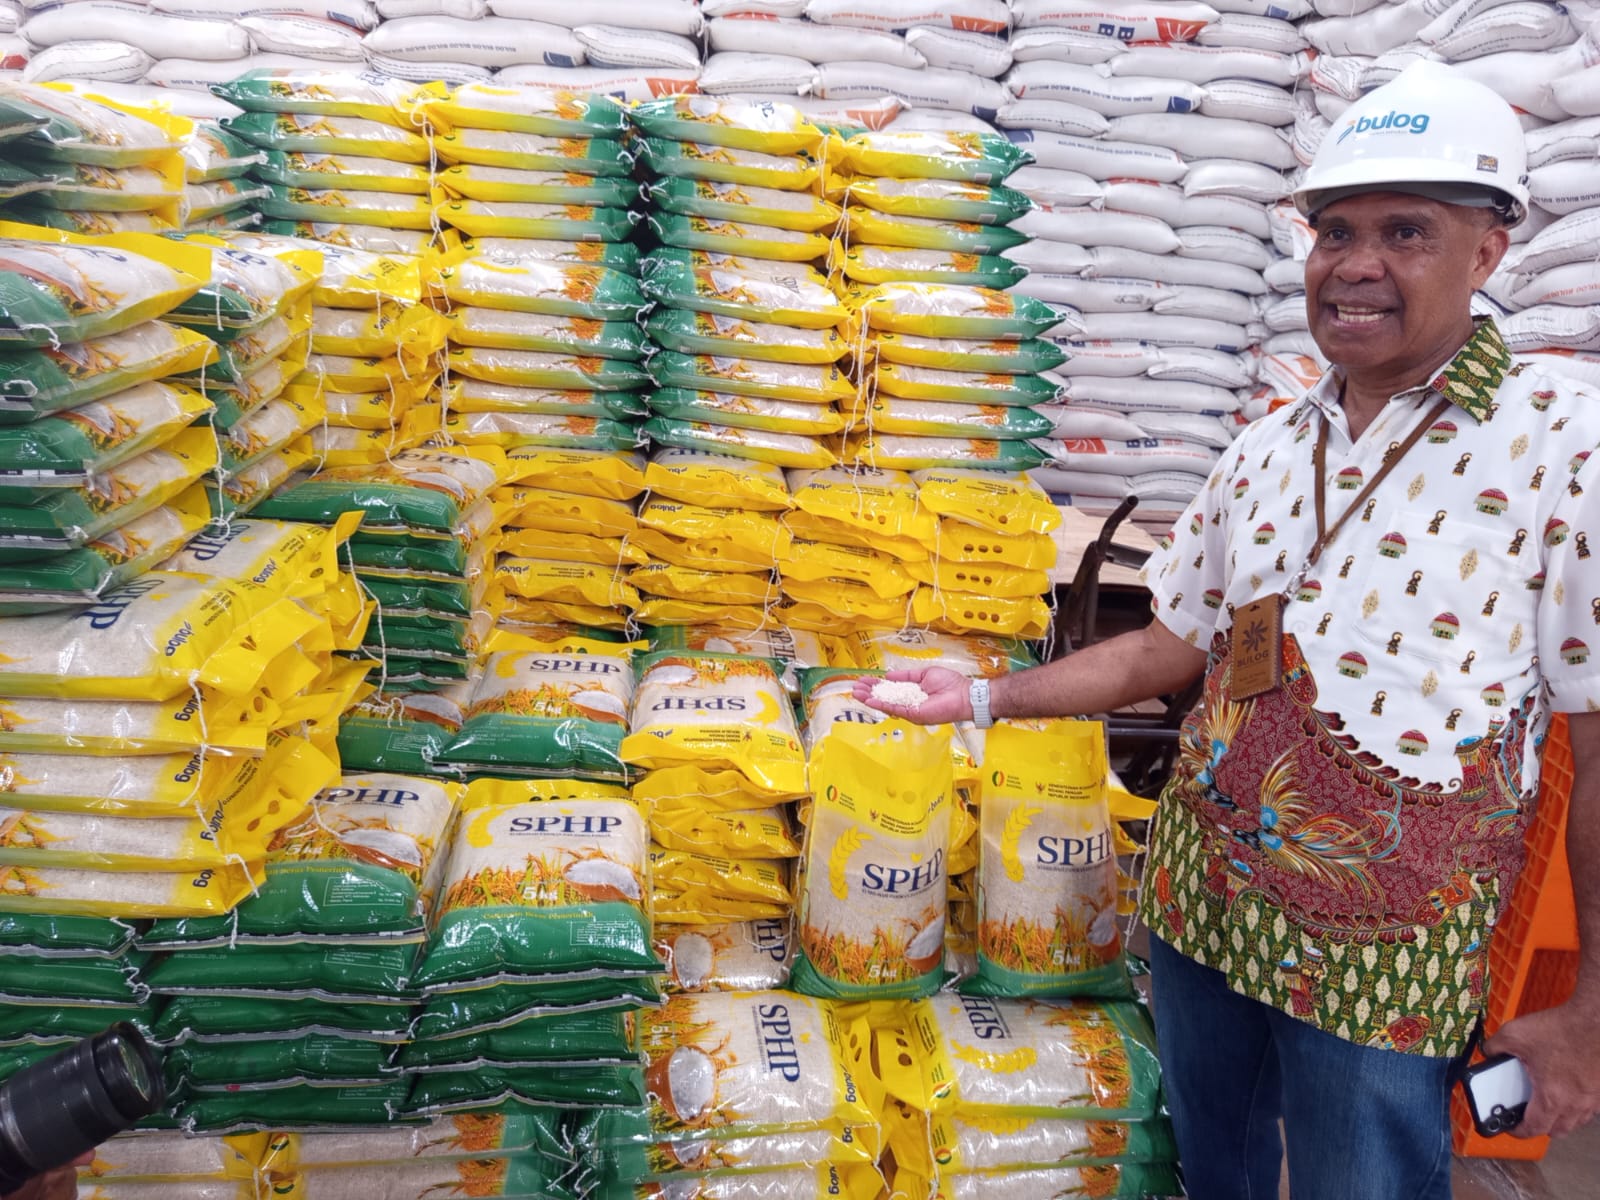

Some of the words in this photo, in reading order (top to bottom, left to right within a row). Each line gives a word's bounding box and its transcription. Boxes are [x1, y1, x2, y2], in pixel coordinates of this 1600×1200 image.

[1355, 110, 1430, 134] bulog
[530, 659, 621, 674] SPHP
[1237, 650, 1269, 667] BULOG
[652, 698, 746, 711] SPHP
[510, 815, 622, 833] SPHP
[862, 848, 943, 893] SPHP
[523, 887, 536, 900] 5
[1052, 950, 1064, 965] 5
[1065, 952, 1080, 966] kg
[868, 965, 881, 979] 5
[881, 967, 897, 979] kg
[961, 994, 1006, 1039] SPH
[759, 1004, 800, 1083] SPHP
